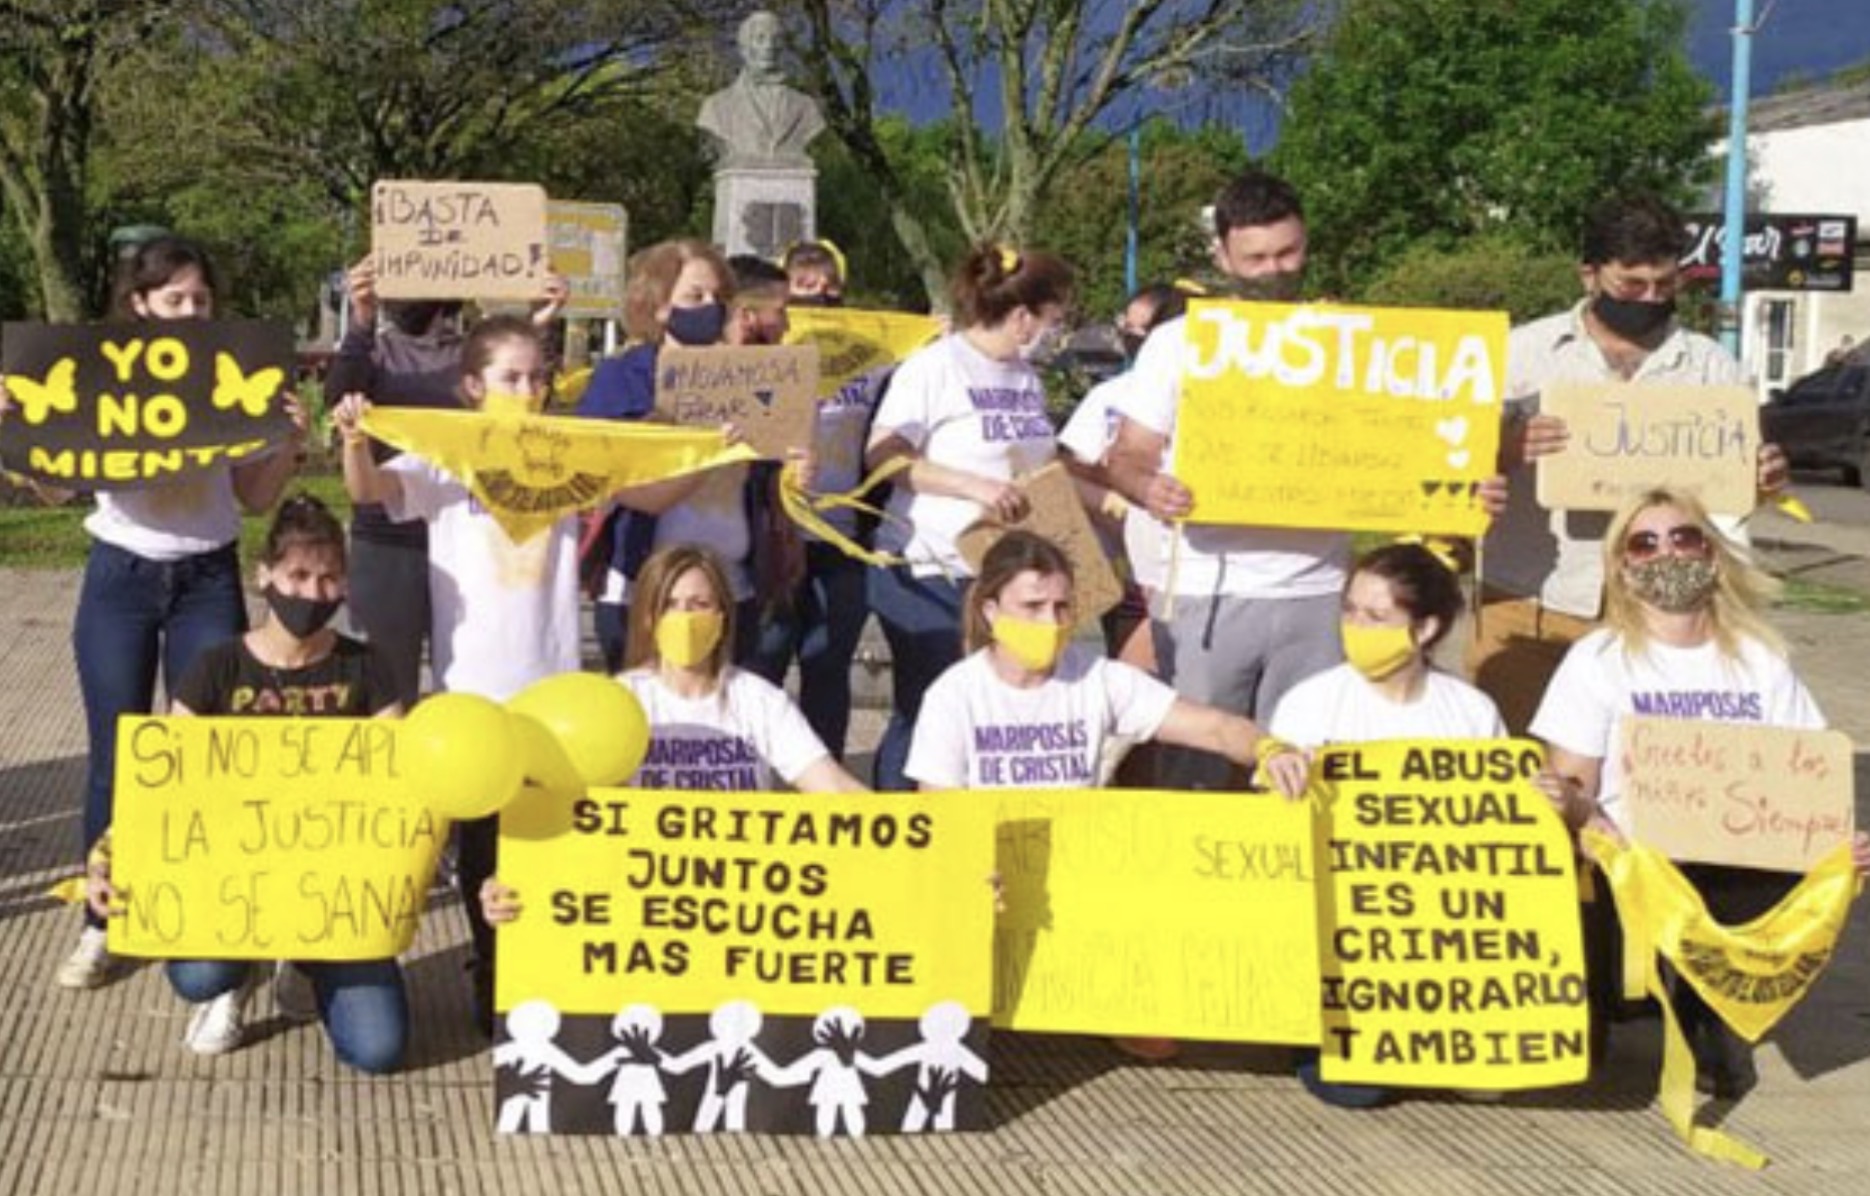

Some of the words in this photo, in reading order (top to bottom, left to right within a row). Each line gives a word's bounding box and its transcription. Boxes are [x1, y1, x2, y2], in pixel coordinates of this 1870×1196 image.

[101, 337, 189, 383] YO
[1185, 307, 1497, 405] JUSTICIA
[97, 394, 187, 438] NO
[231, 683, 349, 713] PARTY
[1631, 690, 1763, 720] MARIPOSAS
[206, 727, 259, 779] NO
[278, 725, 320, 779] SE
[334, 722, 401, 778] APL
[974, 720, 1088, 754] MARIPOSAS
[979, 757, 1008, 784] DE
[1010, 753, 1093, 783] CRISTAL
[1323, 751, 1379, 782] EL
[573, 800, 629, 835] SI
[656, 805, 934, 848] GRITAMOS
[1355, 792, 1537, 826] SEXUAL
[161, 808, 210, 863] LA
[627, 849, 829, 896] JUNTOS
[1193, 833, 1316, 882] SEXUAL
[1329, 839, 1563, 876] INFANTIL
[121, 879, 184, 945] NO
[214, 870, 274, 949] SE
[297, 870, 419, 943] SANA
[552, 891, 611, 926] SE
[642, 895, 874, 941] ESCUCHA
[1350, 883, 1415, 917] ES
[1441, 888, 1505, 920] UN
[583, 940, 690, 976] MAS
[725, 946, 915, 986] FUERTE
[1333, 927, 1561, 968] CRIMEN,
[1321, 972, 1587, 1013] IGNORARLO
[1329, 1026, 1584, 1066] TAMBIEN
